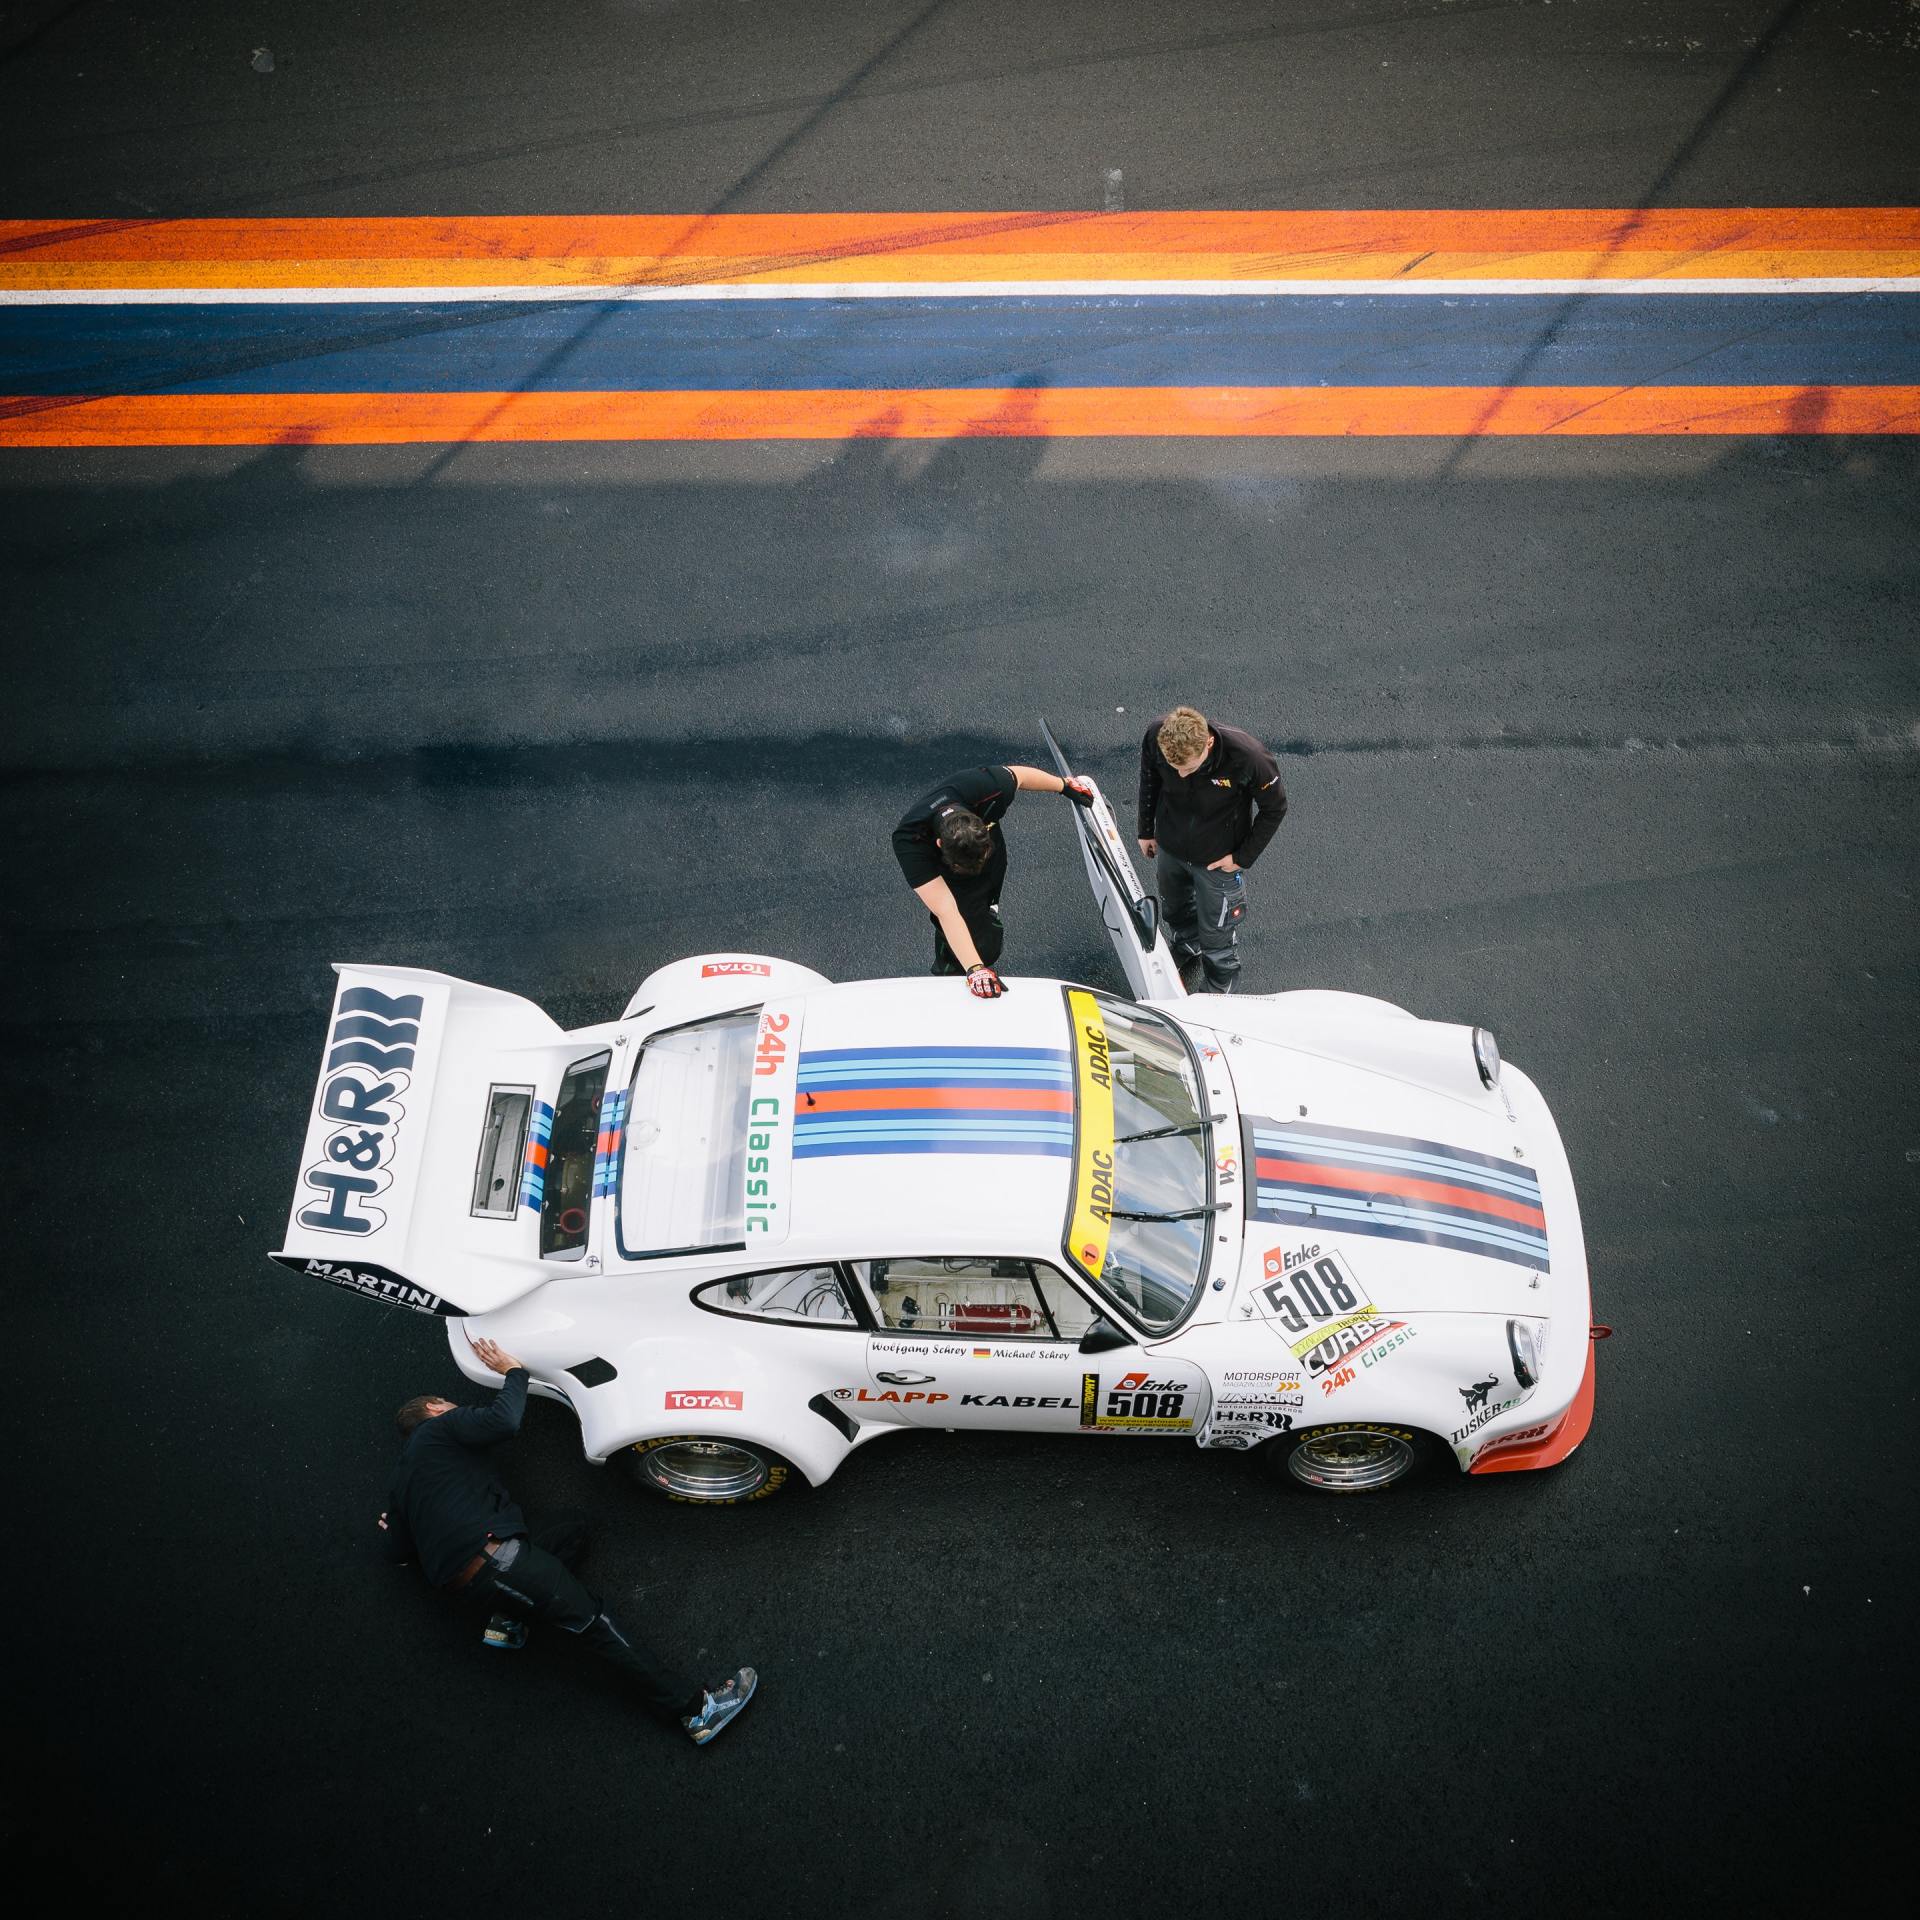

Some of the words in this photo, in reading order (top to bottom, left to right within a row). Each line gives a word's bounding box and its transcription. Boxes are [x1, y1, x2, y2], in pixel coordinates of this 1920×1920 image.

[707, 963, 766, 976] TOTAL
[755, 1013, 790, 1075] 24h
[1086, 1026, 1110, 1090] ADAC
[300, 1076, 396, 1233] H&R
[746, 1097, 780, 1232] Classic
[1090, 1150, 1112, 1224] ADAC
[1283, 1243, 1321, 1270] Enke
[304, 1269, 435, 1314] PORSCHE
[306, 1259, 441, 1309] MARTINI
[1262, 1257, 1358, 1333] 508
[872, 1341, 929, 1355] Wolfgang
[932, 1343, 967, 1356] Schrey
[993, 1348, 1035, 1359] Michael
[1038, 1349, 1070, 1361] Schrey
[1305, 1318, 1391, 1377] CURBS
[1321, 1367, 1356, 1397] 24h
[1361, 1326, 1417, 1369] Classic
[857, 1389, 949, 1404] LAPP
[960, 1394, 1080, 1409] KABEL
[1138, 1380, 1188, 1391] Enke
[1224, 1372, 1302, 1381] MOTORSPORT
[671, 1393, 737, 1409] TOTAL
[1107, 1392, 1184, 1418] 508
[1216, 1411, 1263, 1423] H&R
